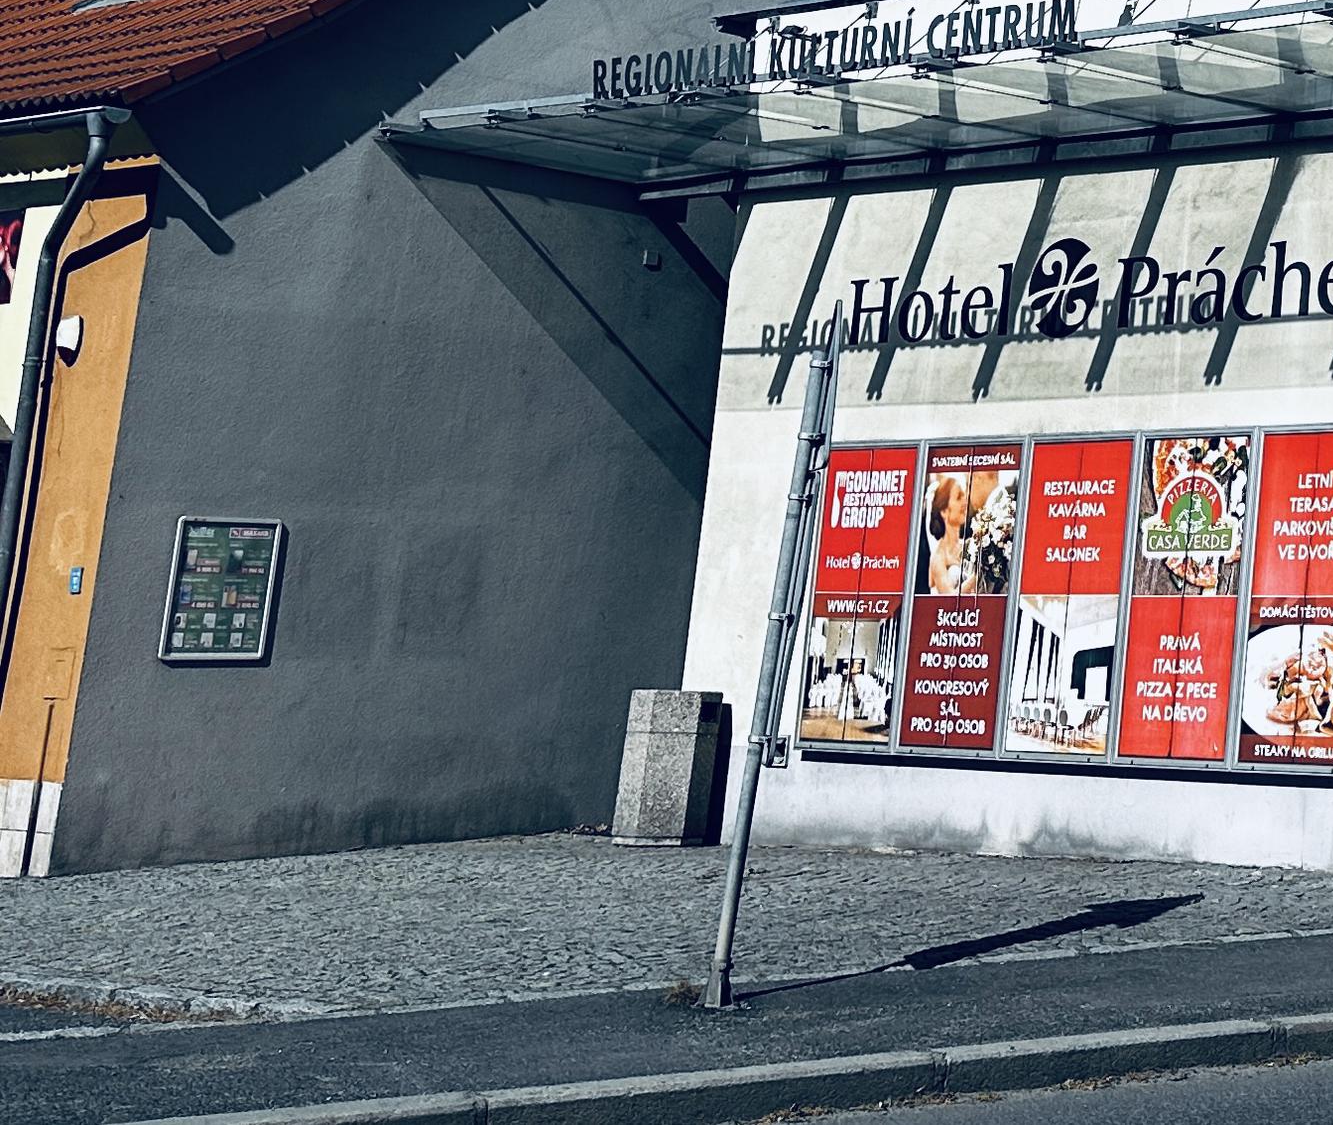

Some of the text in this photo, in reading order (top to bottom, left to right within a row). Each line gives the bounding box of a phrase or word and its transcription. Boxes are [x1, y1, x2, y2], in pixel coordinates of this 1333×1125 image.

[769, 7, 915, 80] KULTURNÍ
[849, 263, 1014, 347] Hotel
[1000, 452, 1016, 464] SÁL
[845, 470, 908, 493] GOURMET
[1043, 479, 1116, 496] RESTAURACE
[843, 492, 905, 507] RESTAURANTS
[1167, 479, 1218, 506] PIZZERIA
[841, 506, 885, 529] GROUP
[1048, 499, 1106, 518] KAVÁRNA
[1063, 524, 1087, 540] BAR
[1148, 534, 1229, 550] CASA VERDE
[1045, 546, 1101, 562] SALONEK
[1277, 544, 1296, 560] VE
[825, 555, 851, 569] Hotel
[1259, 603, 1299, 618] DOMÁCÍ
[929, 629, 984, 647] MÍSTNOST
[1159, 631, 1201, 651] PRAVÁ
[920, 652, 942, 667] PRO
[958, 653, 989, 669] OSOB
[1153, 655, 1204, 674] ITALSKÁ
[914, 678, 990, 696] KONGRESOVÝ
[1136, 681, 1218, 700] PIZZA Z PECE
[940, 698, 961, 716] SÁL
[1142, 702, 1208, 722] NA DŘEVO
[910, 717, 932, 732] PRO
[956, 719, 986, 735] OSOB
[1254, 744, 1291, 757] STEAKY
[1291, 745, 1307, 758] NA
